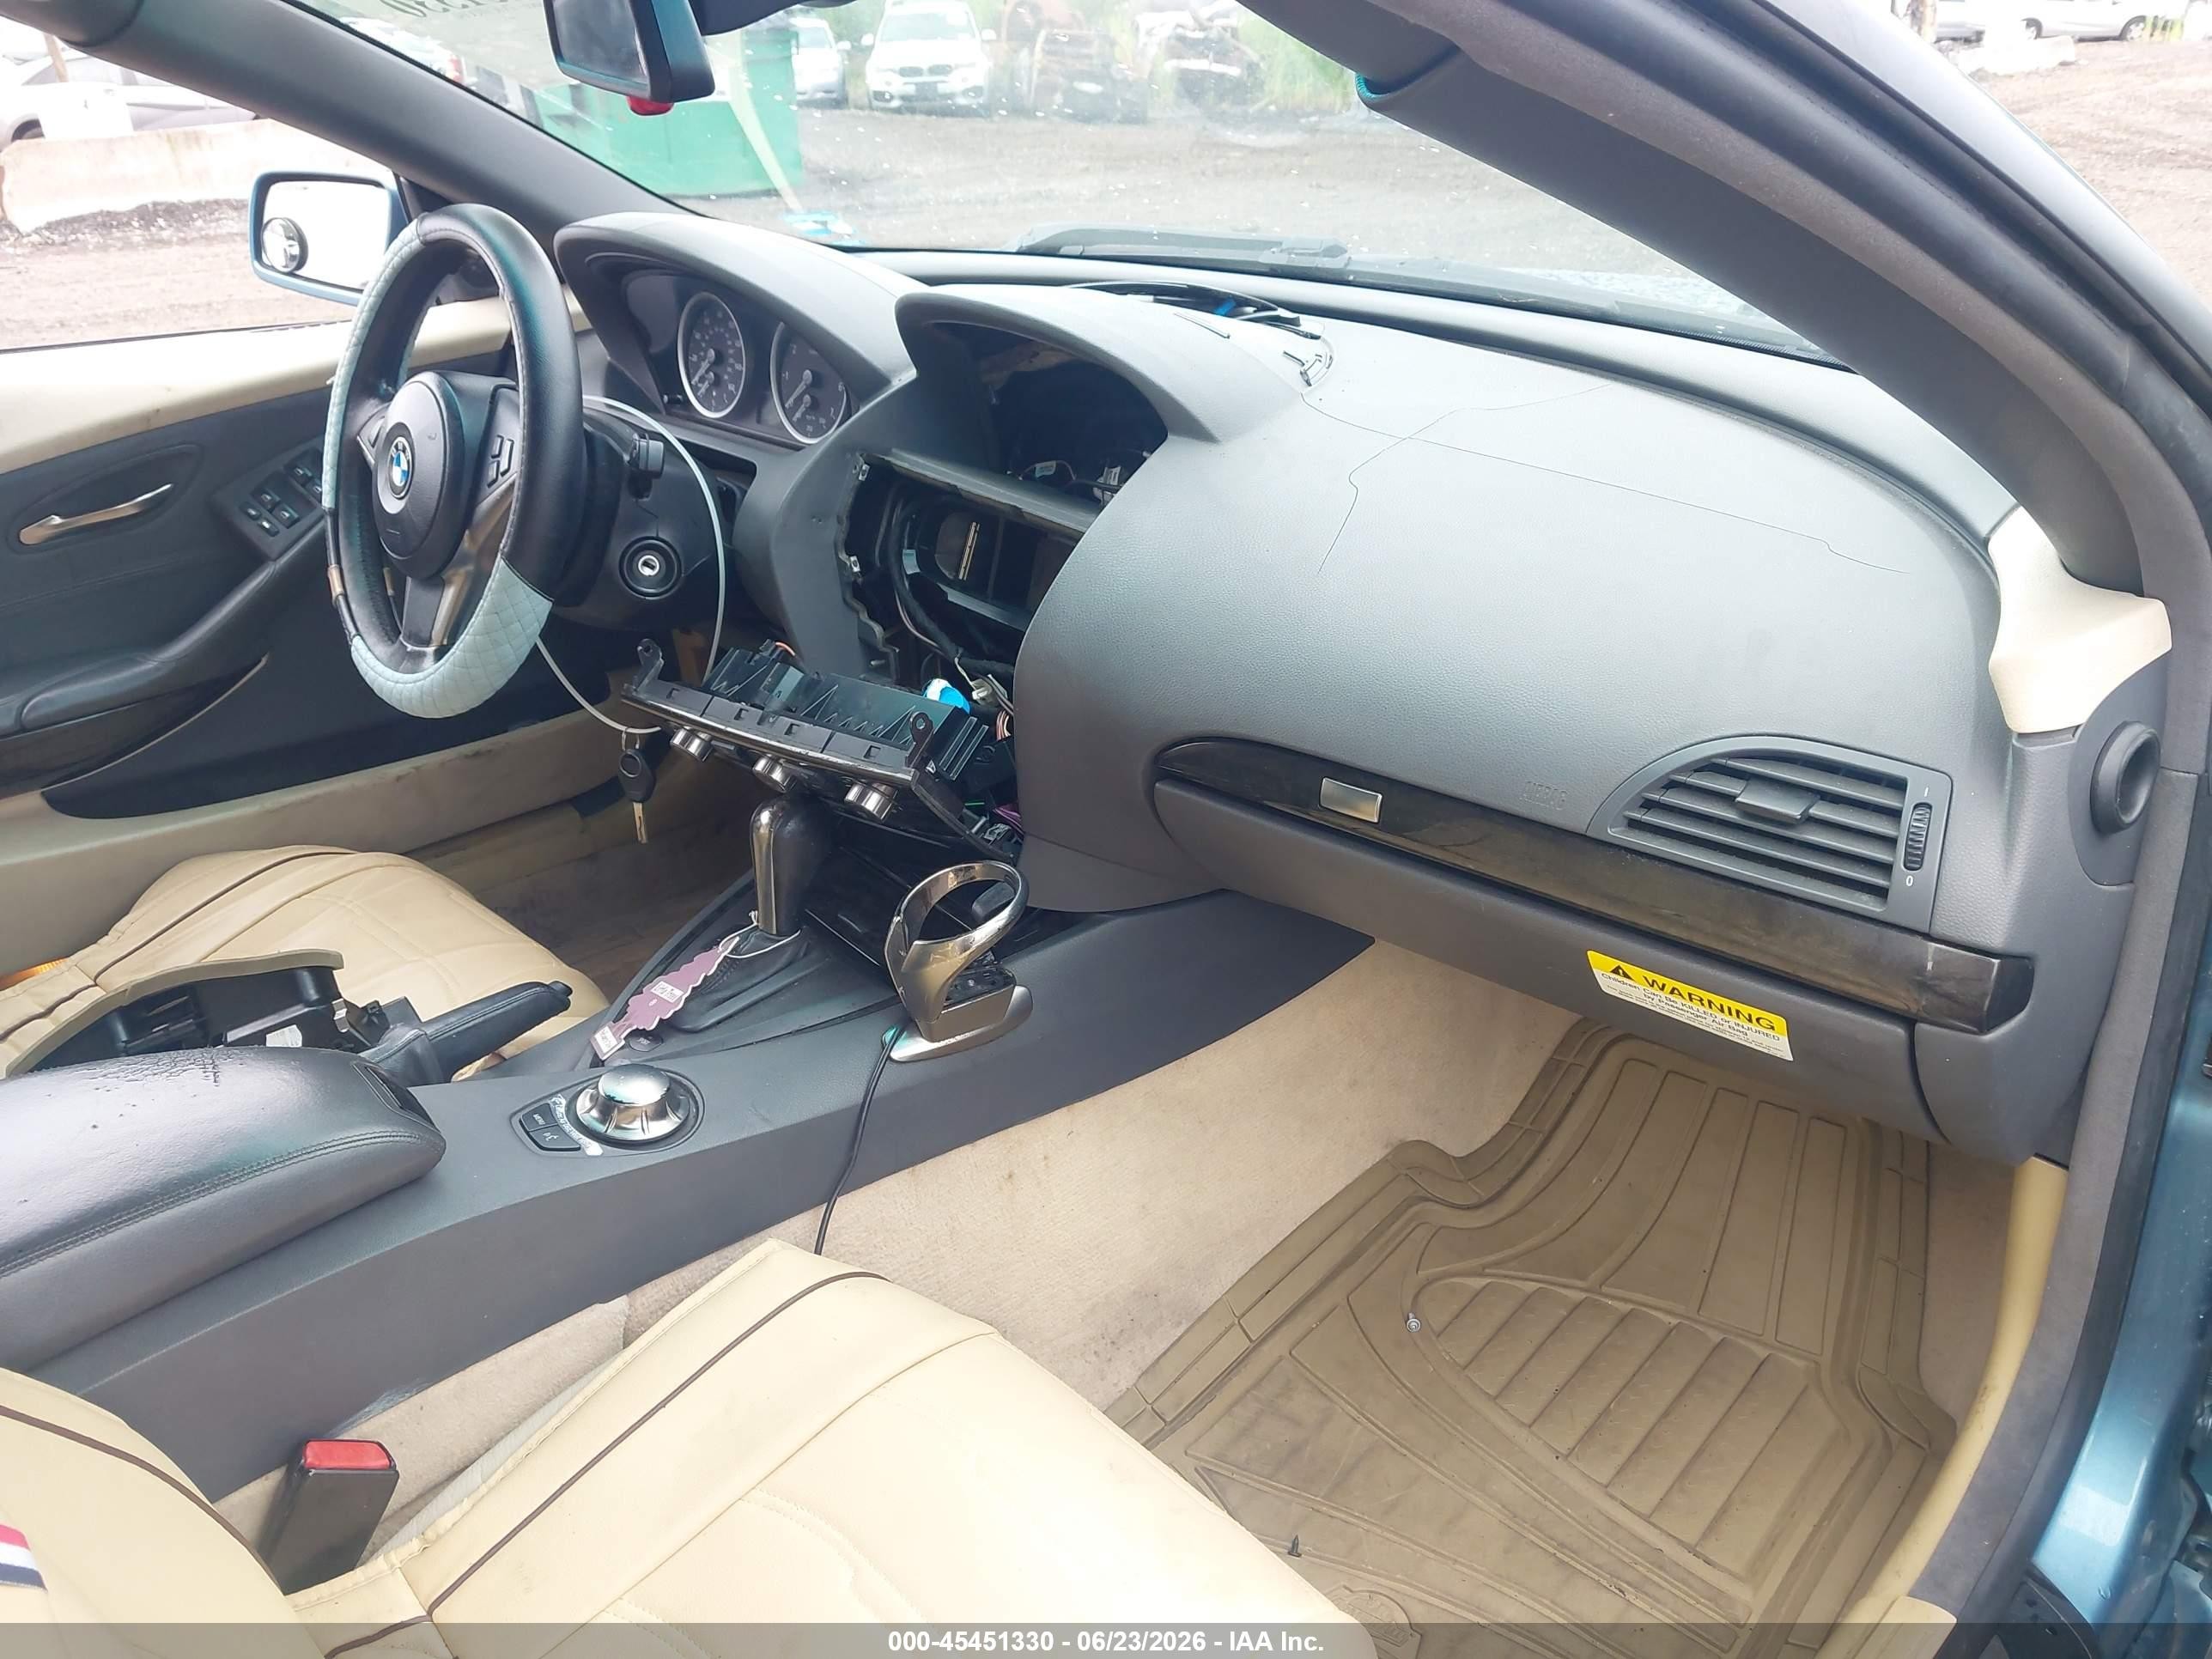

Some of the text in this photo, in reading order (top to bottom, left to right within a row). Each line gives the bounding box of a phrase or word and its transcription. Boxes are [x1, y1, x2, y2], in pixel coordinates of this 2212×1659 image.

[1601, 973, 1641, 990] Children
[1644, 988, 1662, 999] Can
[1664, 996, 1678, 1005] Be
[1681, 1002, 1718, 1019] KILLED
[1734, 1021, 1780, 1042] INJURED
[1643, 975, 1776, 1031] WARNING
[1644, 993, 1655, 1002] by
[1657, 998, 1707, 1021] Passenger
[1711, 1018, 1725, 1029] Air
[1728, 1024, 1748, 1037] Bag
